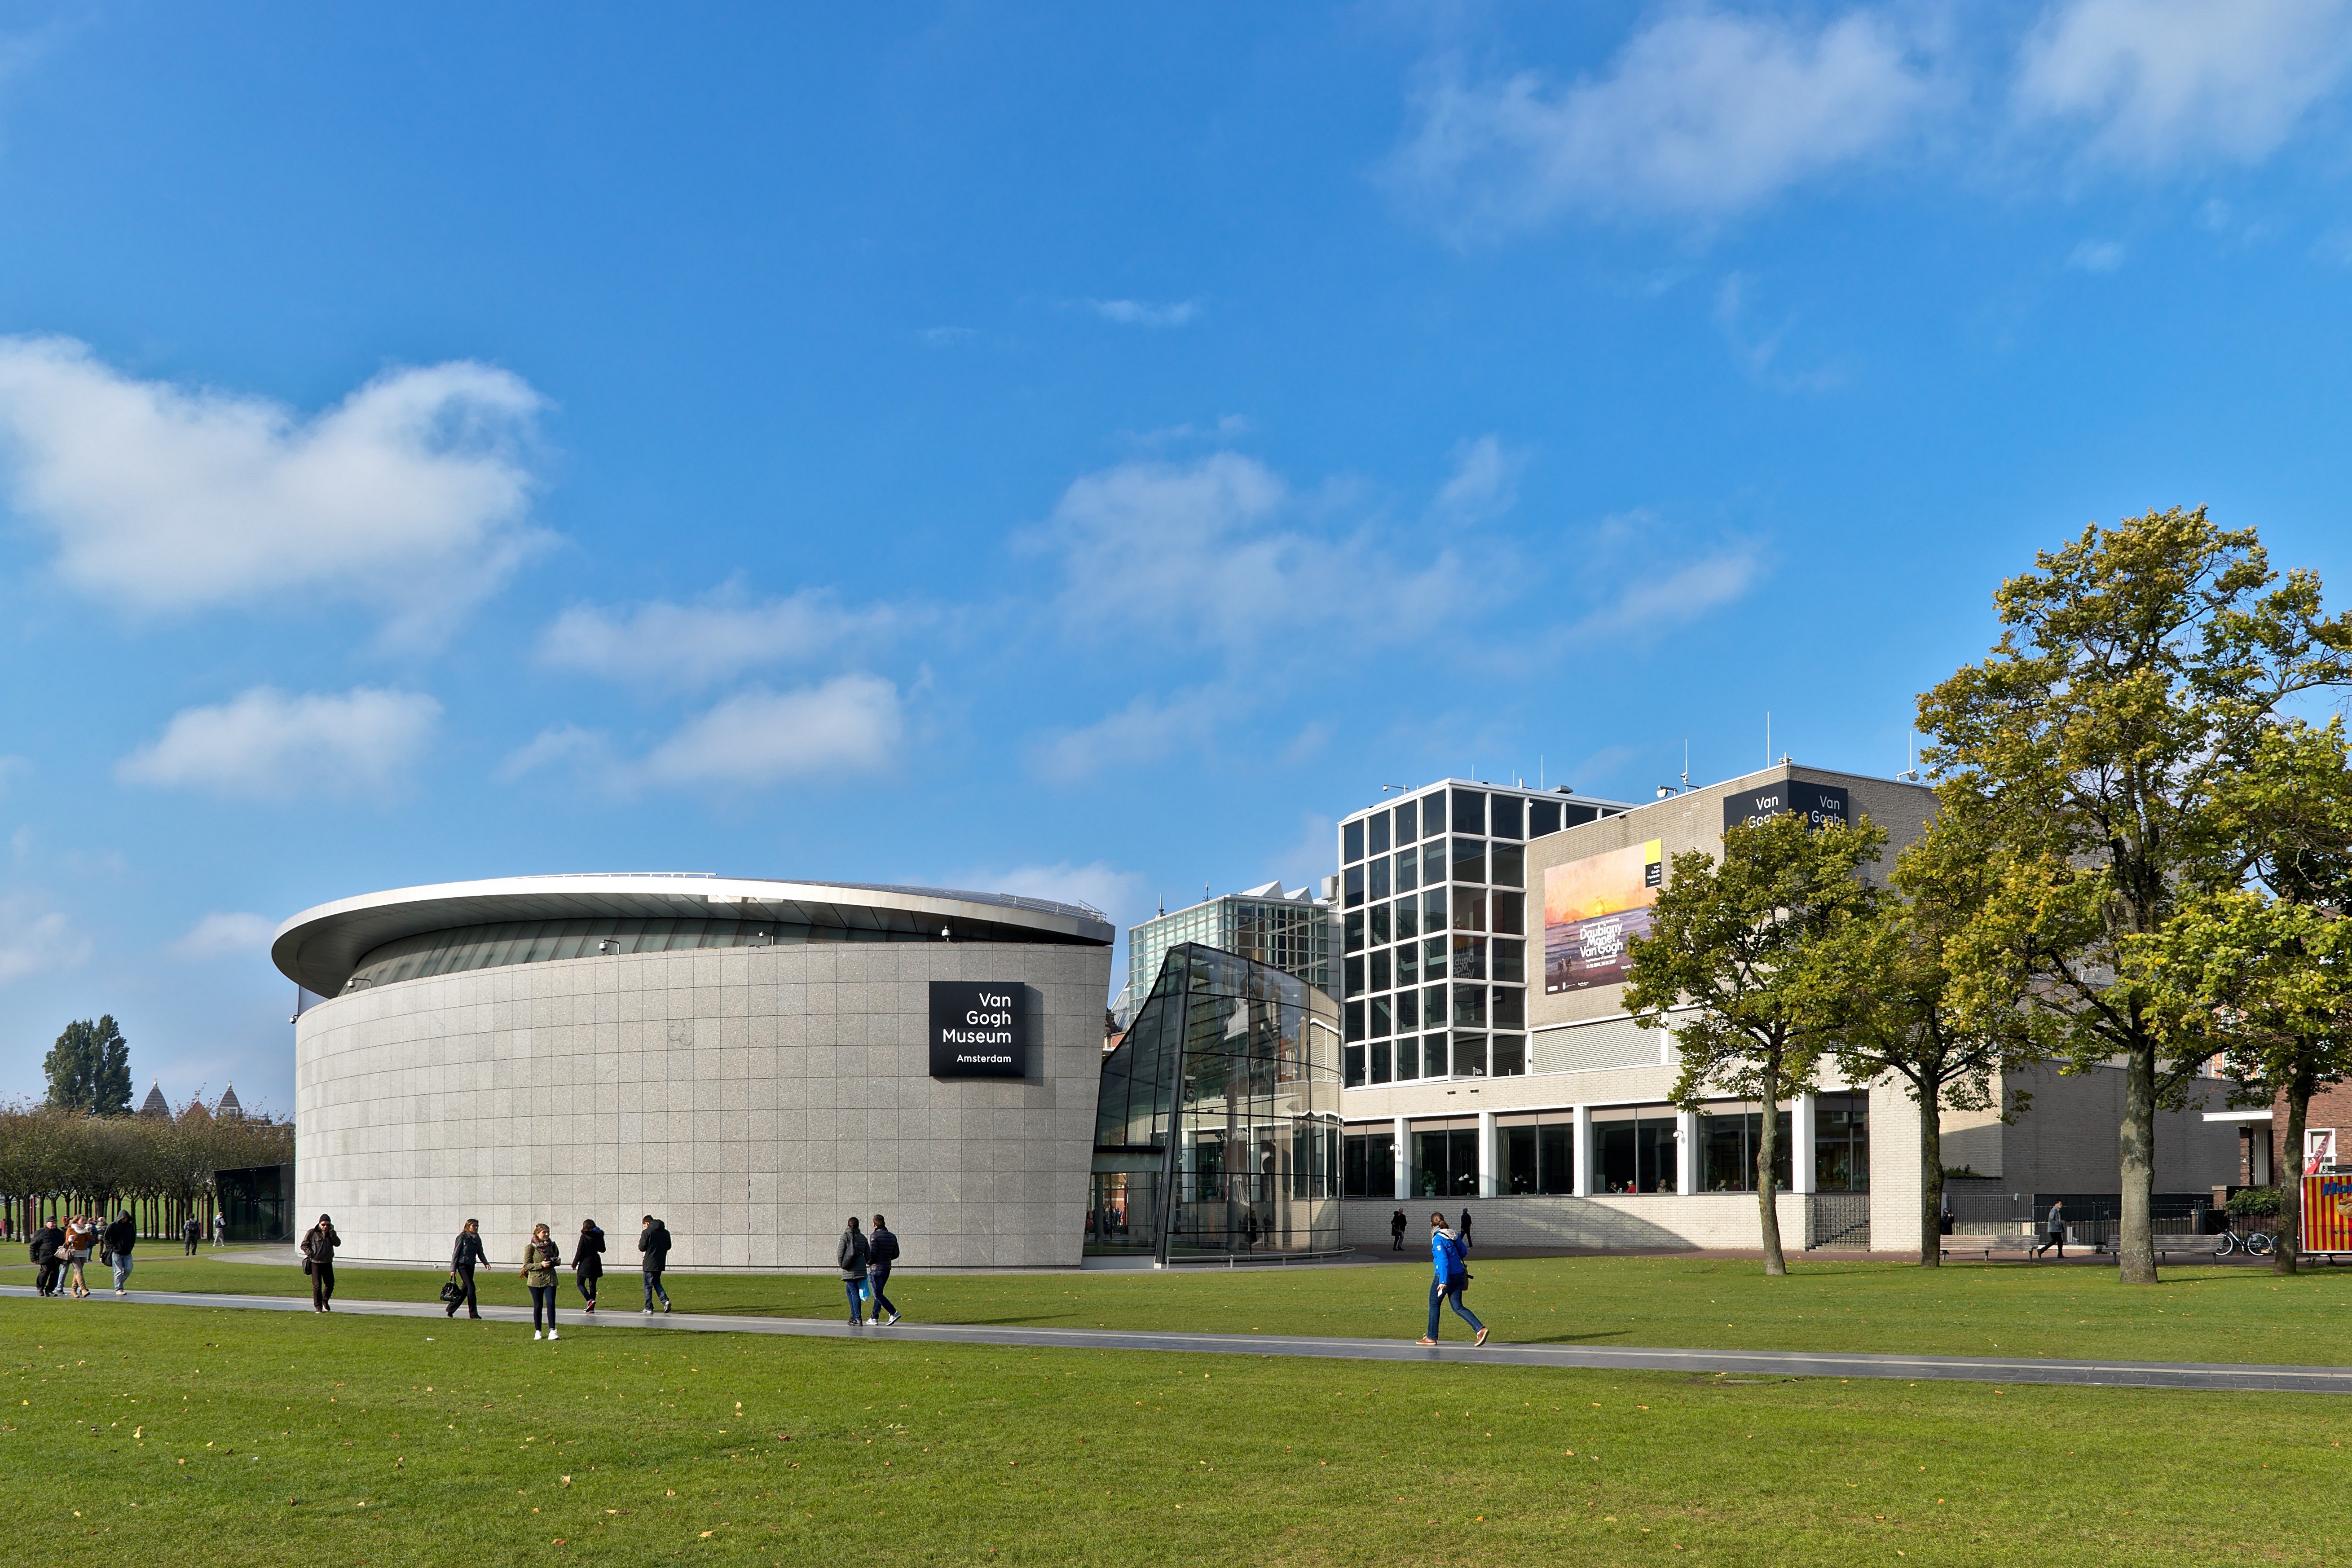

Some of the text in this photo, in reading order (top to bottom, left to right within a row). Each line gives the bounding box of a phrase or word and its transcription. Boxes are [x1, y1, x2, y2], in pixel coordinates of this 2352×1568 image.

[1756, 796, 1778, 810] Van
[1819, 795, 1840, 810] Van
[1580, 923, 1623, 940] Daubigny
[1586, 933, 1616, 947] Monet
[1579, 938, 1623, 958] Van Gogh
[979, 993, 1011, 1007] Van
[966, 1010, 1011, 1027] Gogh
[943, 1029, 1011, 1043] Museum
[956, 1054, 1011, 1063] Amsterdam
